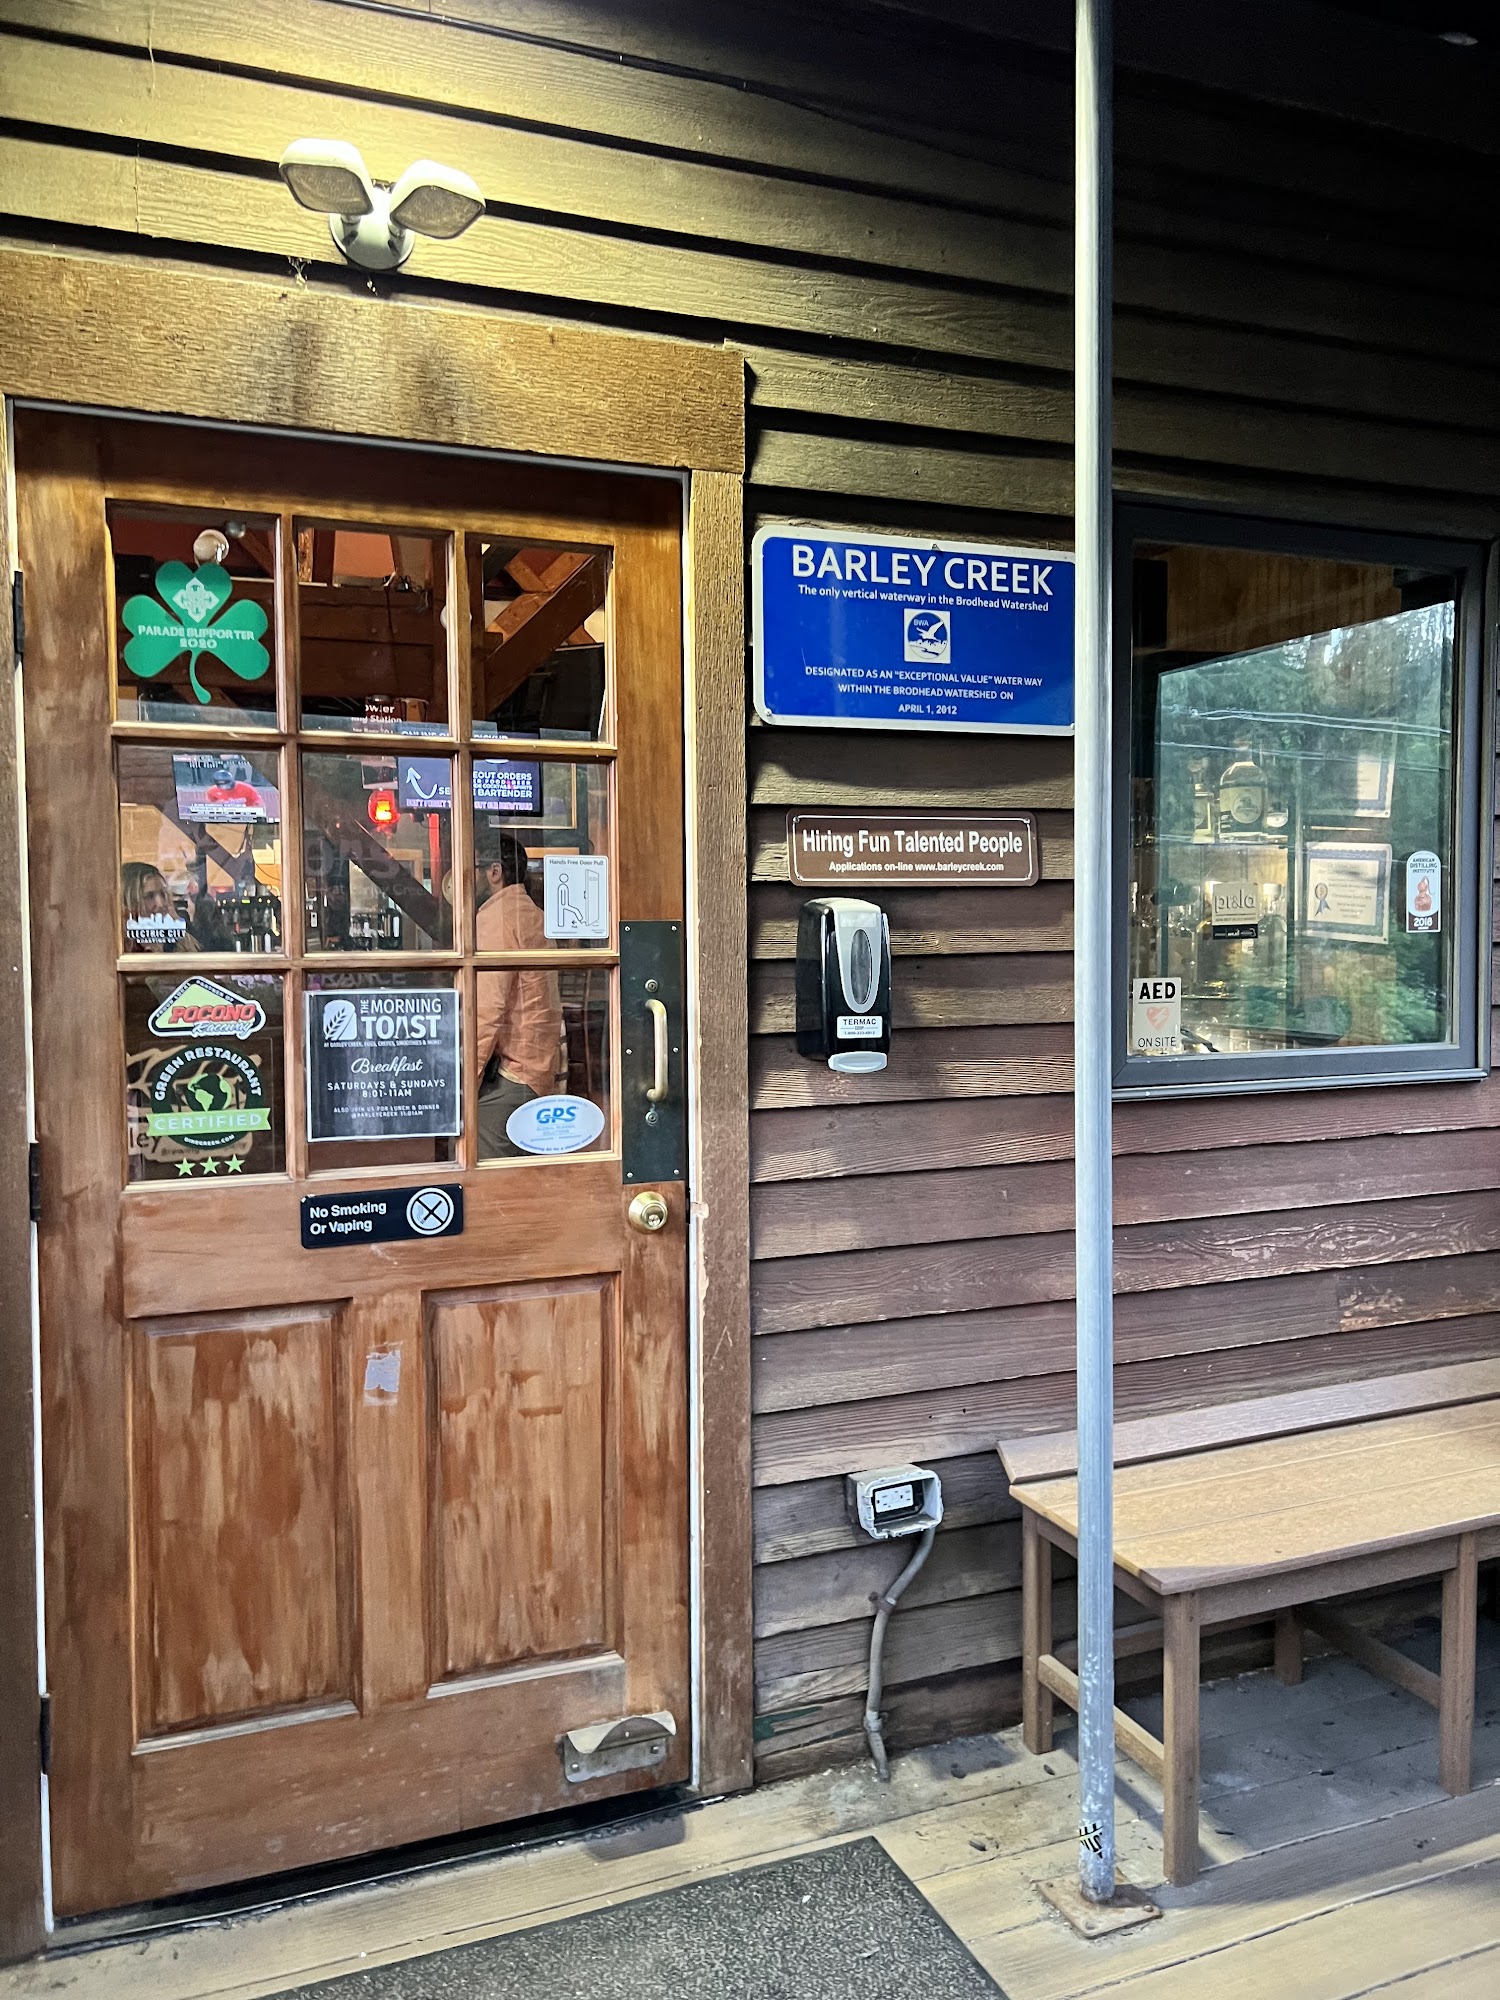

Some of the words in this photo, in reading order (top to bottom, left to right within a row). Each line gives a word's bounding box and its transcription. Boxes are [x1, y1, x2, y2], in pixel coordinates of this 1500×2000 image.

[792, 544, 936, 586] BARLEY
[944, 557, 1053, 596] CREEK
[798, 584, 817, 596] The
[819, 586, 840, 600] only
[842, 587, 878, 601] vertical
[880, 591, 926, 605] waterway
[928, 594, 936, 604] in
[939, 595, 954, 606] the
[956, 596, 999, 609] Brodhead
[1001, 599, 1048, 612] Watershed
[913, 618, 929, 627] BWA
[138, 624, 185, 637] PARADE
[186, 627, 255, 641] SUPPORTER
[180, 638, 218, 649] 2020
[805, 666, 864, 678] DESIGNATED
[866, 669, 878, 679] AS
[879, 669, 893, 679] AN
[895, 670, 959, 683] "EXCEPTIONAL
[960, 674, 992, 685] VALUE"
[994, 675, 1022, 685] WATER
[1023, 677, 1043, 687] WAY
[838, 684, 872, 694] WITHIN
[872, 684, 891, 695] THE
[893, 685, 944, 698] BRODHEAD
[945, 688, 997, 700] WATERSHED
[1000, 691, 1014, 700] ON
[898, 704, 924, 714] APRIL
[926, 704, 934, 716] 1,
[935, 704, 957, 715] 2012
[497, 772, 532, 781] ORDERS
[478, 789, 532, 798] BARTENDER
[802, 829, 853, 857] Hiring
[859, 829, 890, 853] Fun
[894, 830, 964, 853] Talented
[969, 831, 1023, 858] People
[829, 861, 882, 873] Applications
[884, 862, 913, 872] on-line
[915, 862, 1004, 873] www.barleycreek.com
[1413, 917, 1433, 927] 2018
[1139, 981, 1176, 1000] AED
[168, 1004, 256, 1024] POCONO
[360, 999, 369, 1014] THE
[371, 998, 442, 1014] MORNING
[843, 1018, 877, 1026] TERMAC
[1138, 1037, 1153, 1048] ON
[1154, 1036, 1176, 1047] SITE
[154, 1057, 185, 1101] GREEN
[184, 1046, 262, 1097] RESTAURANT
[350, 1056, 424, 1077] Breakfast
[327, 1081, 386, 1091] SATURDAYS
[390, 1081, 397, 1089] &
[401, 1079, 446, 1089] SUNDAYS
[154, 1113, 263, 1131] CERTIFIED
[536, 1106, 577, 1124] GPS
[309, 1206, 329, 1219] No
[330, 1201, 387, 1217] Smoking
[309, 1222, 327, 1235] Or
[329, 1219, 373, 1235] Vaping
